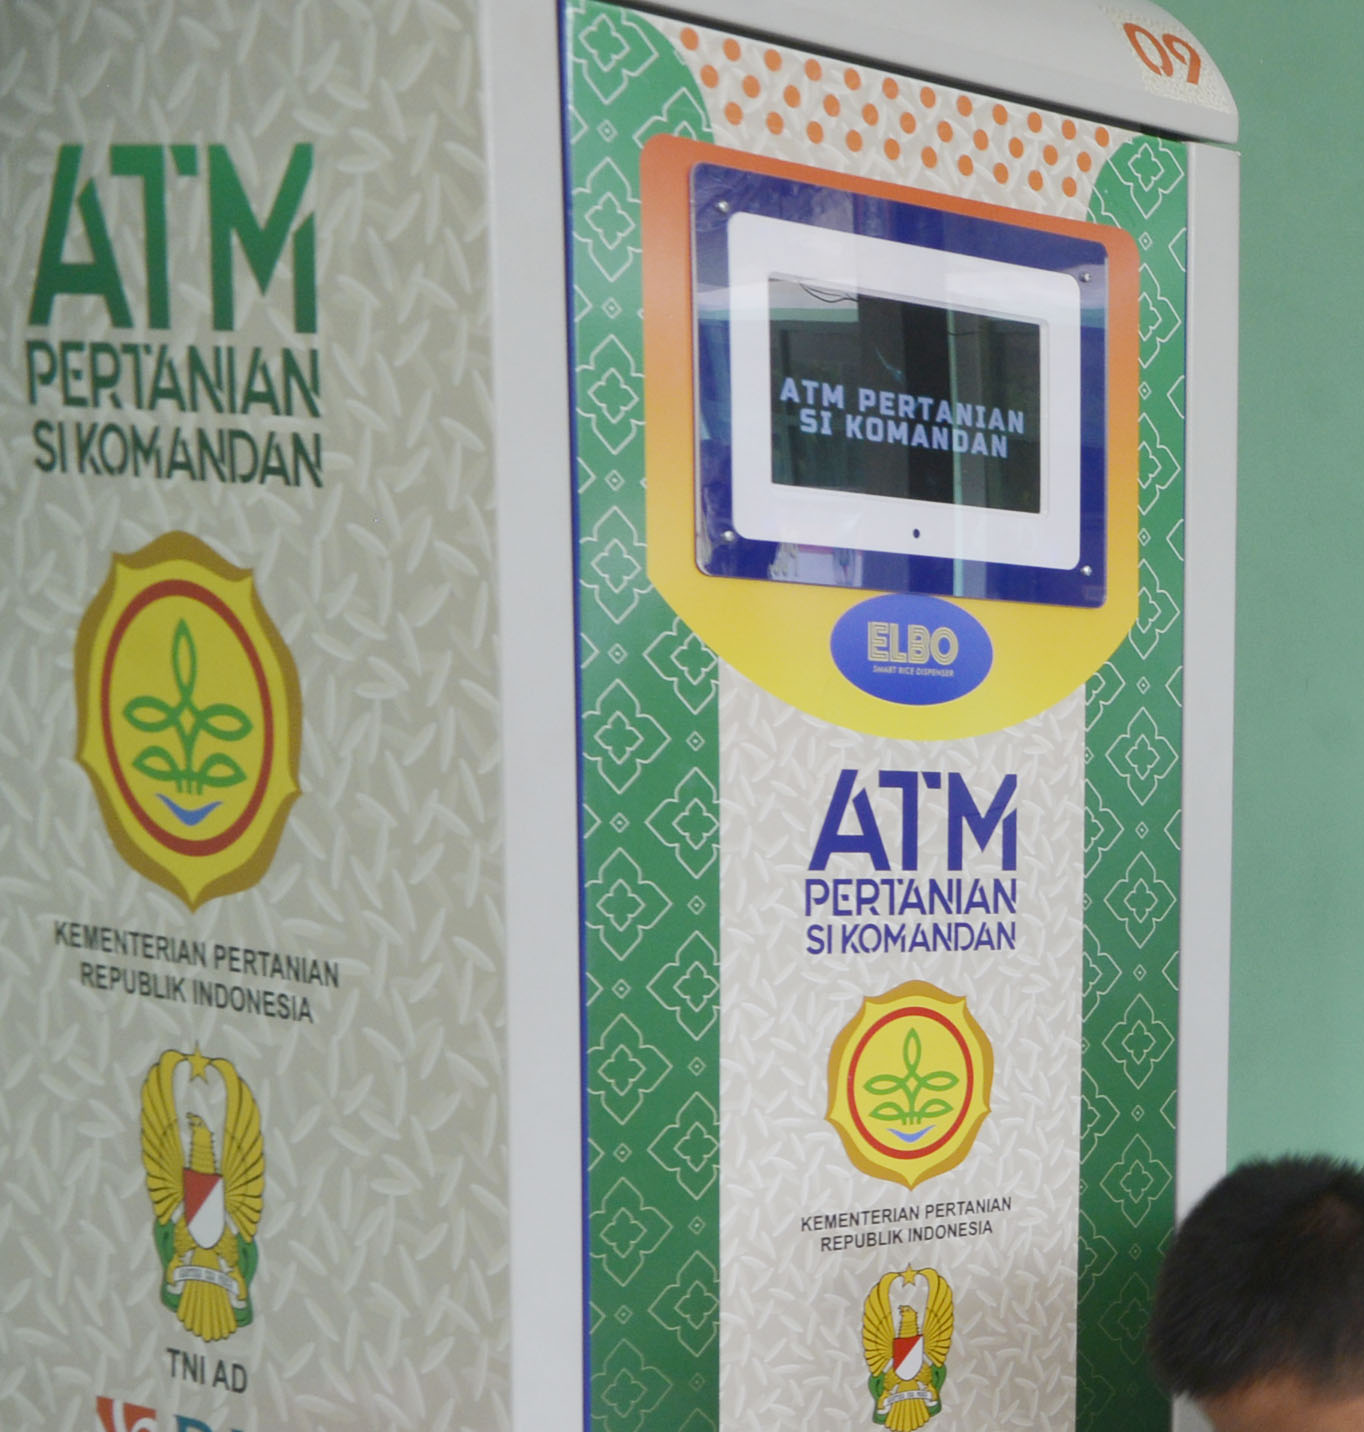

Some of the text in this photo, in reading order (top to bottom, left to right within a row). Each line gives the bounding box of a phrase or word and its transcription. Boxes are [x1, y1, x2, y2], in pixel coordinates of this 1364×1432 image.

[1123, 22, 1201, 85] 09
[28, 143, 317, 334] ATM
[25, 339, 321, 418] PERTANIAN
[780, 376, 1025, 435] ATM PERTANIAN
[33, 420, 323, 488] SI KOMANDAN
[799, 408, 1008, 459] SI KOMANDAN
[867, 621, 959, 666] ELBO
[807, 768, 1018, 871] ATM
[804, 878, 1017, 917] PERTANIAN
[54, 920, 339, 988] KEMENTERIAN PERTANIAN
[806, 921, 1016, 955] SI KOMANDAN
[80, 961, 314, 1023] REPUBLIK INDONESIA
[800, 1196, 1012, 1232] KEMENTERIAN PERTANIAN
[820, 1220, 993, 1252] REPUBLIK INDONESIA
[166, 1347, 248, 1394] TNI AD
